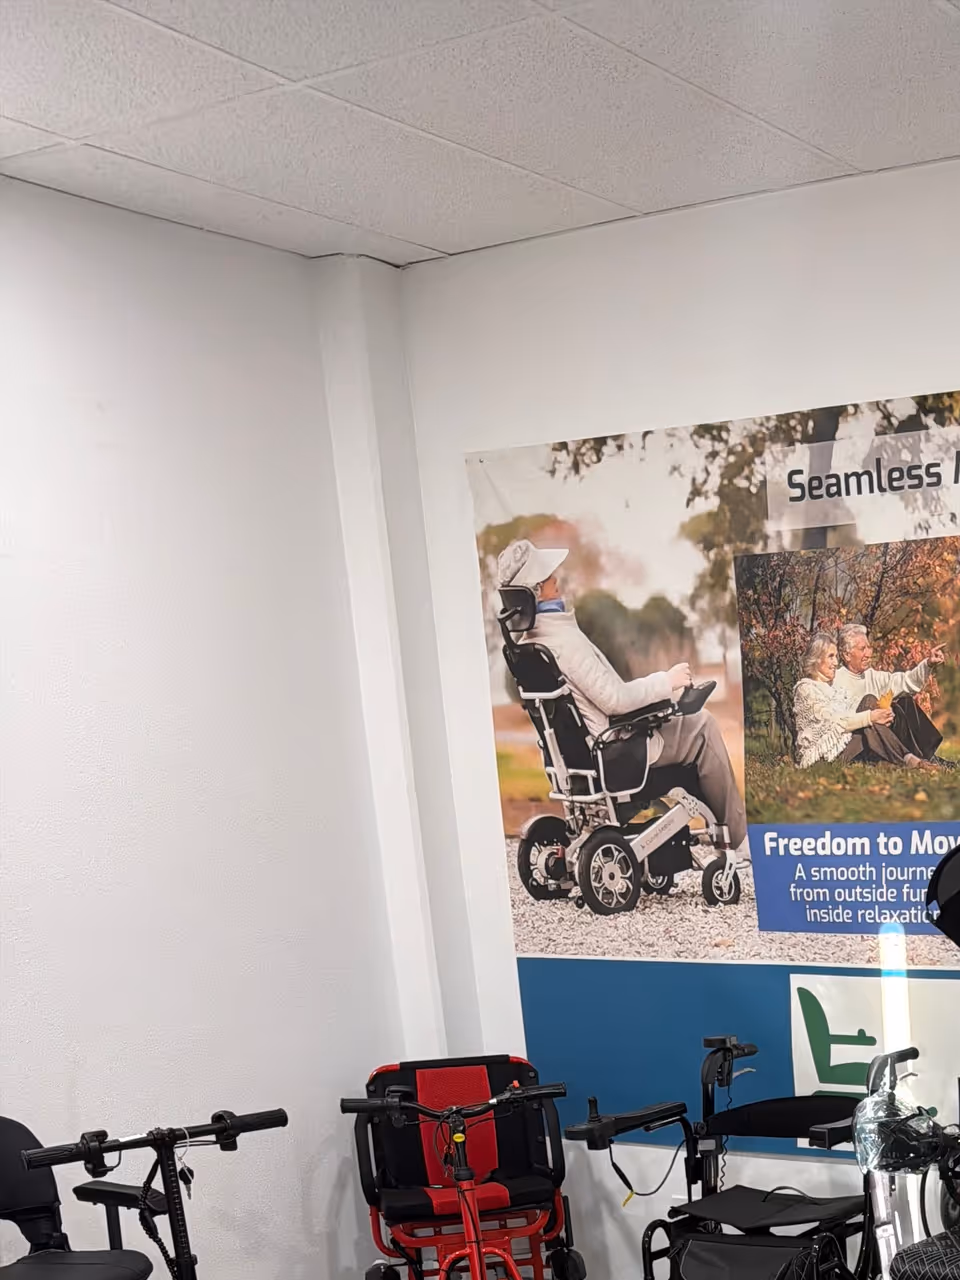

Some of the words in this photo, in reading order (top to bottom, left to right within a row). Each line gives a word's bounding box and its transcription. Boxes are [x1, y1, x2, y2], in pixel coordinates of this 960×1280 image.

[787, 457, 942, 503] Seamless
[763, 830, 870, 856] Freedom
[877, 832, 903, 855] to
[794, 863, 806, 881] A
[811, 862, 876, 881] smooth
[881, 863, 937, 886] journe
[790, 884, 830, 902] from
[834, 883, 897, 902] outside
[806, 905, 853, 923] inside
